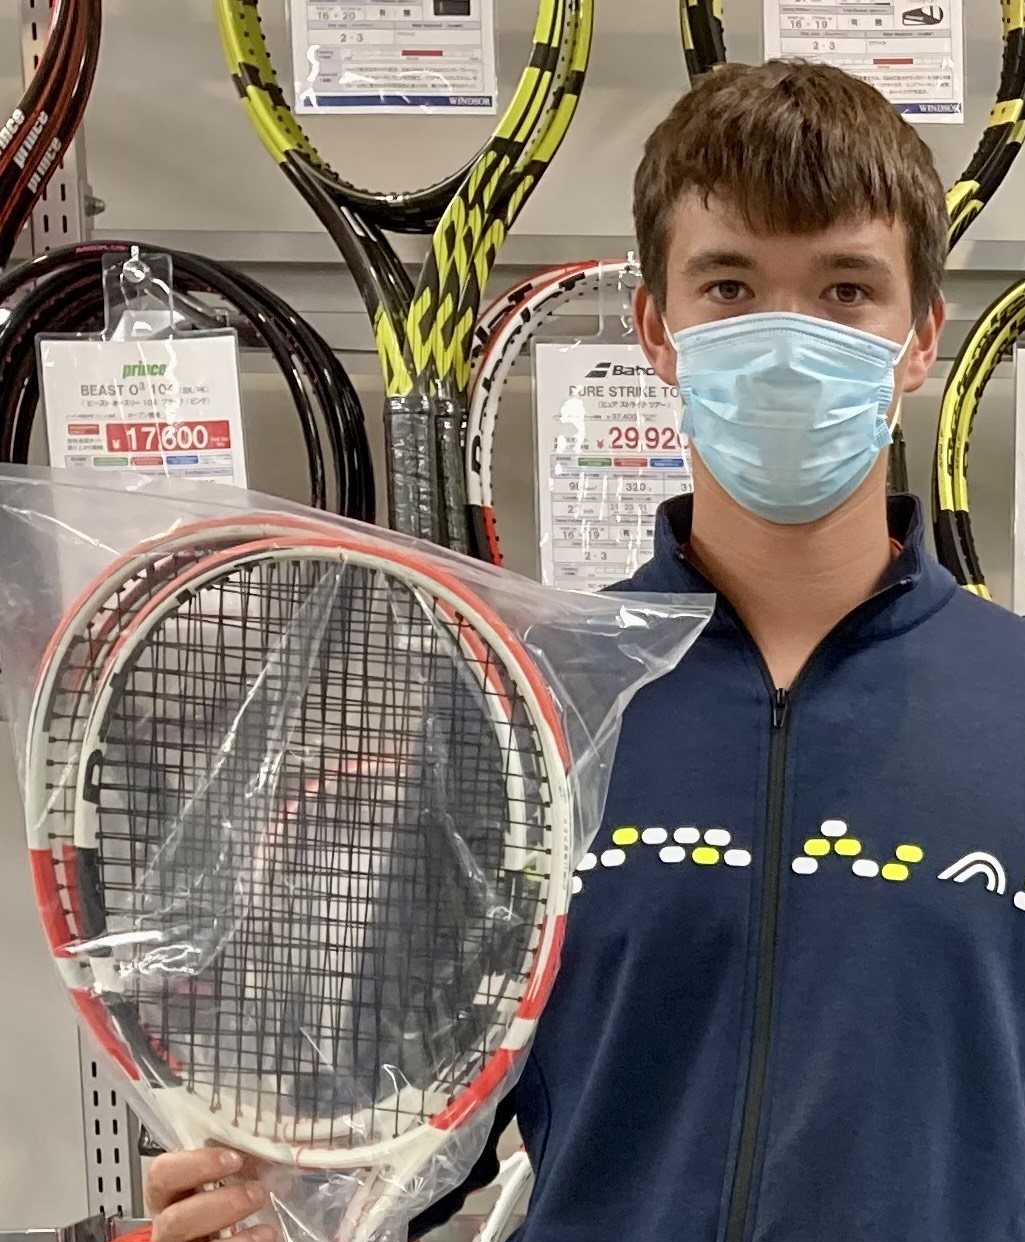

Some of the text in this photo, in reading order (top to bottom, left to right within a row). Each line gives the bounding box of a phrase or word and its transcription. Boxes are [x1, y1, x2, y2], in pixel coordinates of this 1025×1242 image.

[790, 20, 802, 28] 16
[450, 97, 490, 105] WINDSOR
[13, 110, 49, 169] prince
[27, 136, 62, 193] prince
[81, 384, 125, 396] BEAST
[609, 386, 657, 398] STRIKE
[660, 386, 681, 398] TO
